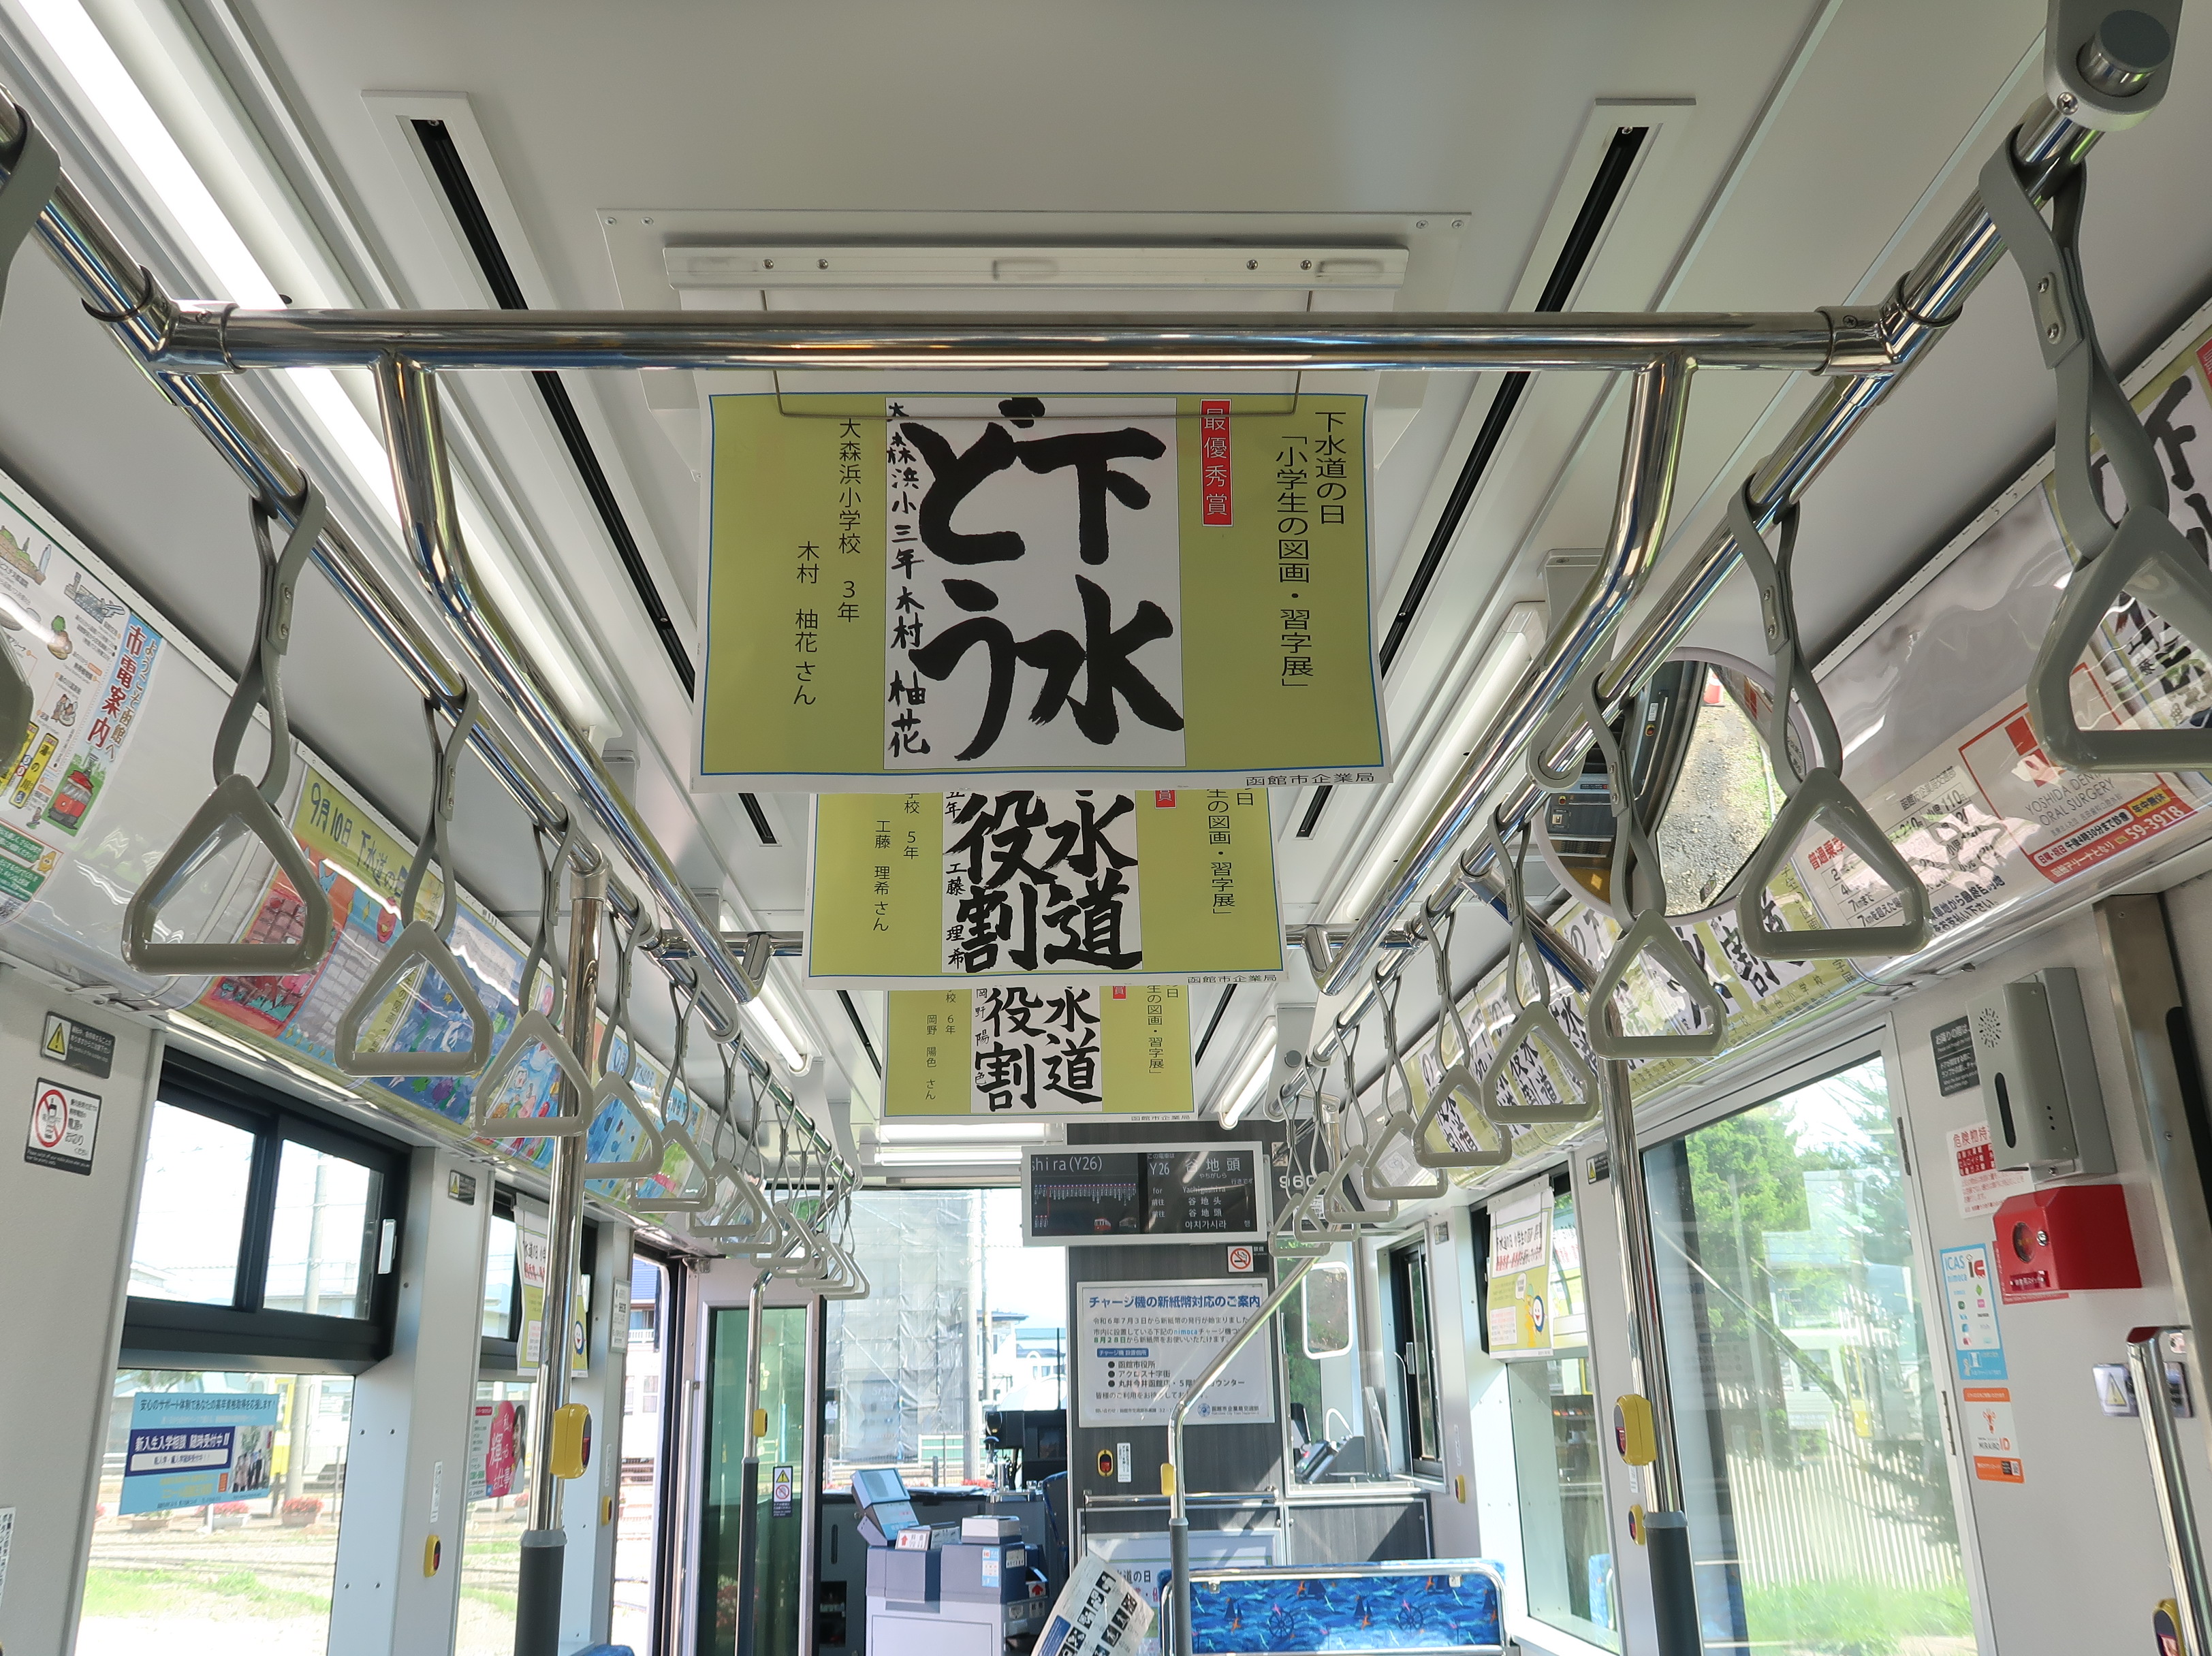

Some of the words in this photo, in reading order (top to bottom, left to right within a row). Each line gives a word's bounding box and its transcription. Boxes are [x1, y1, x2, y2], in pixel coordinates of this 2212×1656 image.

[1204, 409, 1227, 515] 最優秀賞
[1315, 412, 1347, 524] 下水道の日
[838, 418, 862, 554] 大森浜小学校
[797, 541, 819, 584] 木村
[900, 398, 1045, 761] どう
[1276, 436, 1314, 686] 「小学生の図画・習字展」
[838, 581, 859, 623] 3年
[1016, 428, 1184, 745] 下水
[87, 624, 147, 749] 市電案内
[1235, 788, 1254, 806] 日
[1246, 772, 1374, 786] 函館市企業局
[2025, 785, 2072, 815] YOSHIDA
[2039, 804, 2070, 826] ORAL
[2066, 777, 2116, 811] SURGERY
[875, 821, 891, 849] 工藤
[2124, 805, 2186, 841] 59-3918
[904, 831, 919, 859] 5年
[1039, 791, 1142, 970] 水道
[1166, 985, 1179, 998] 日
[1187, 974, 1277, 983] 函館市企業局
[927, 1015, 937, 1035] 岡野
[945, 1015, 955, 1034] 6年
[975, 987, 1047, 1112] 役割
[1149, 1162, 1170, 1176] Y26
[1089, 1295, 1261, 1308] チャージ機の新紙幣対応のご案内
